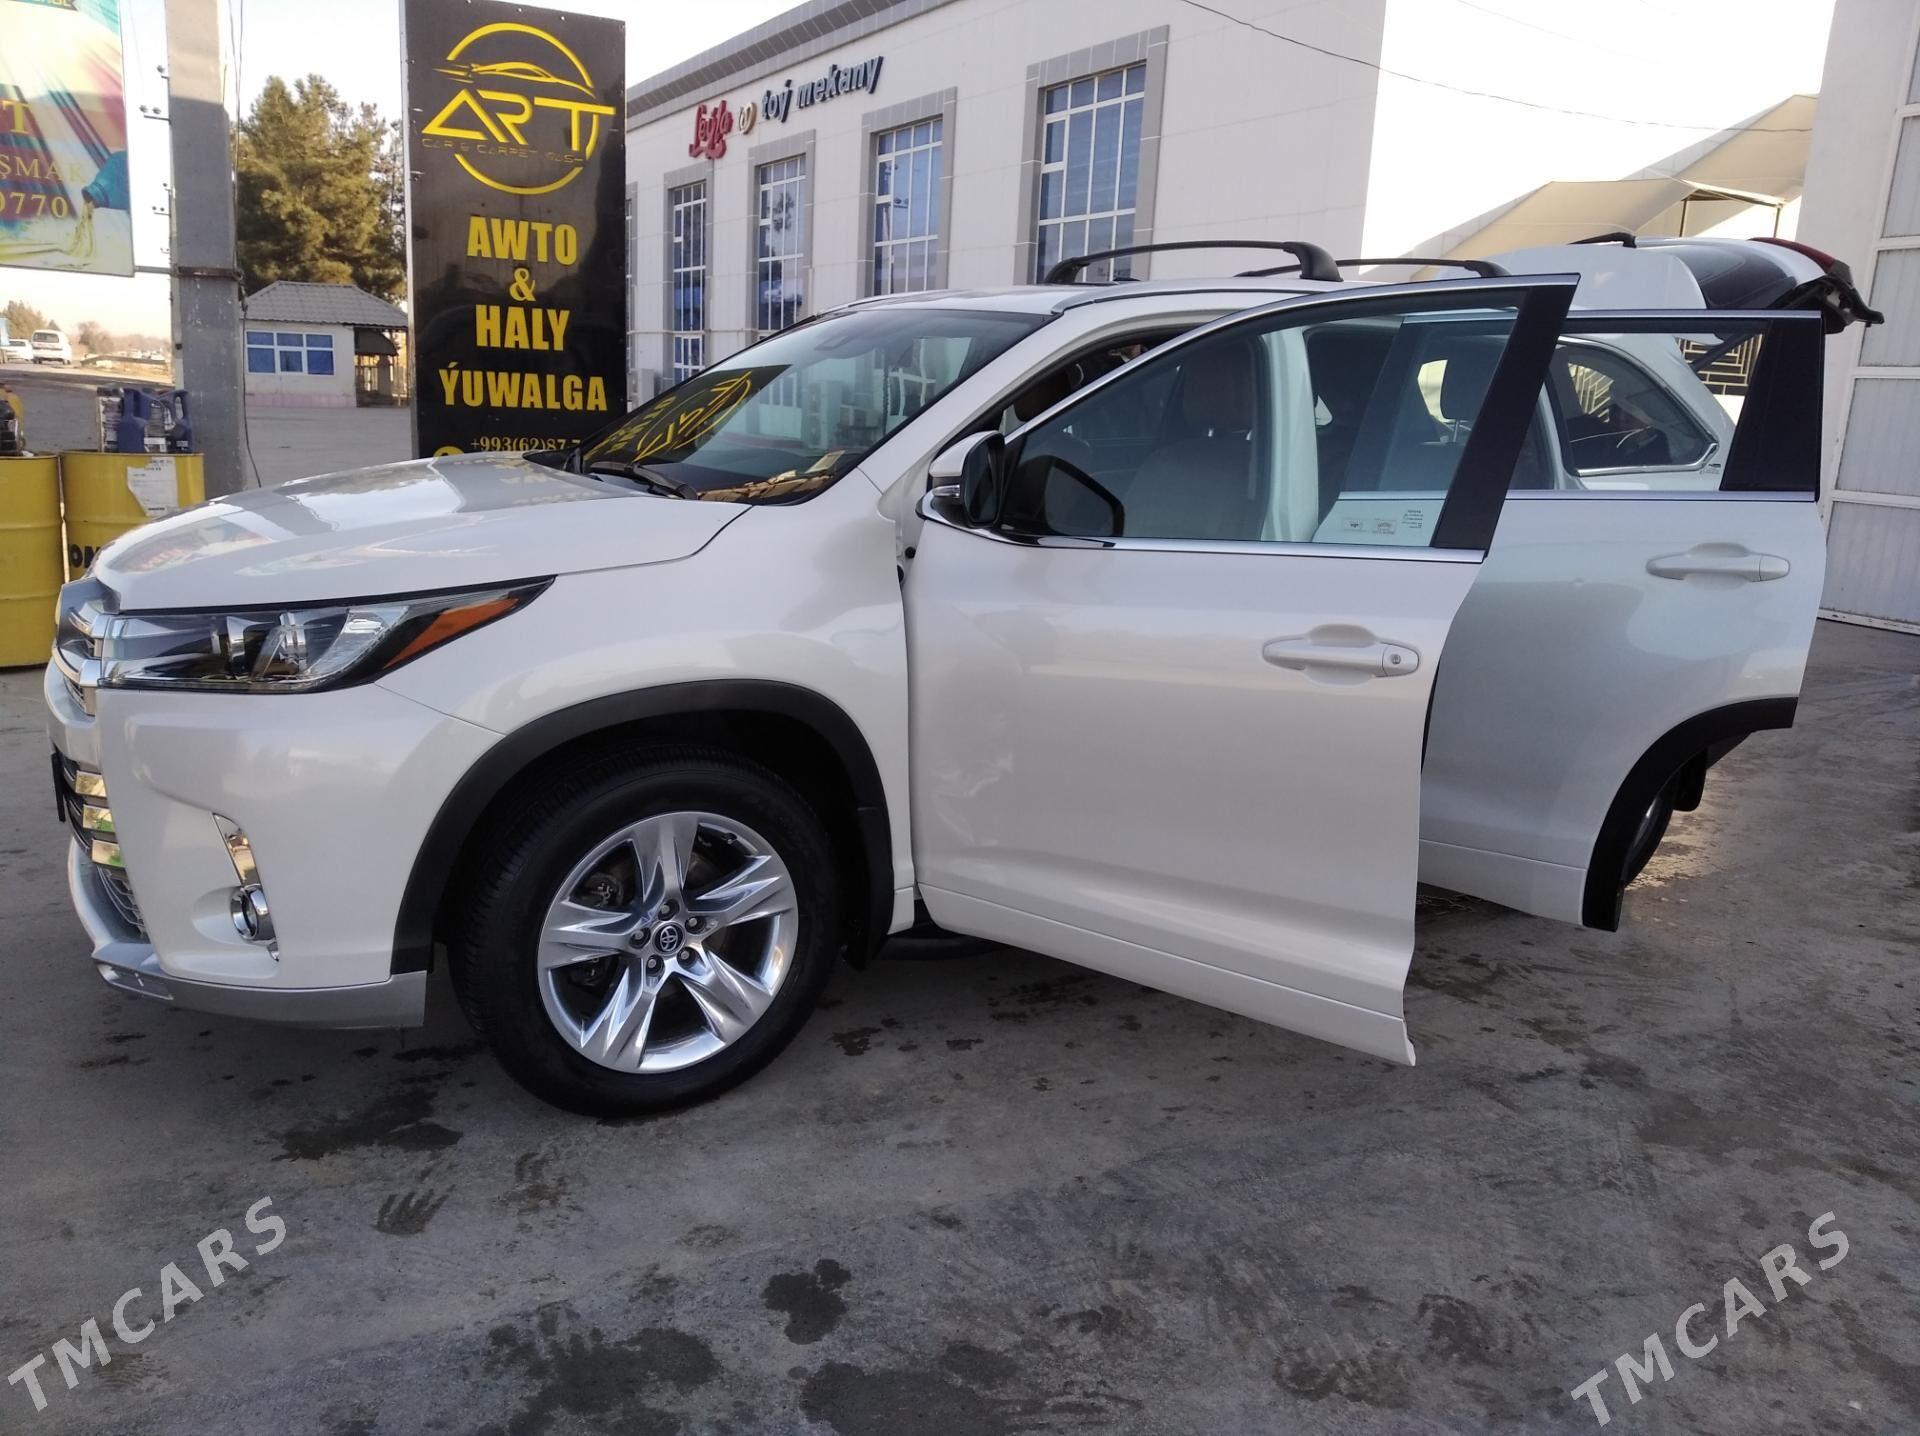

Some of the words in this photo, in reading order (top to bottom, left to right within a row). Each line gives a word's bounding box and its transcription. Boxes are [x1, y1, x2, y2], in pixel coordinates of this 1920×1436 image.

[796, 55, 885, 109] mekany
[421, 87, 617, 152] ART
[466, 215, 578, 266] AWTO
[508, 266, 537, 302] &
[475, 303, 570, 352] HALY
[438, 361, 608, 412] ÝUWALGA
